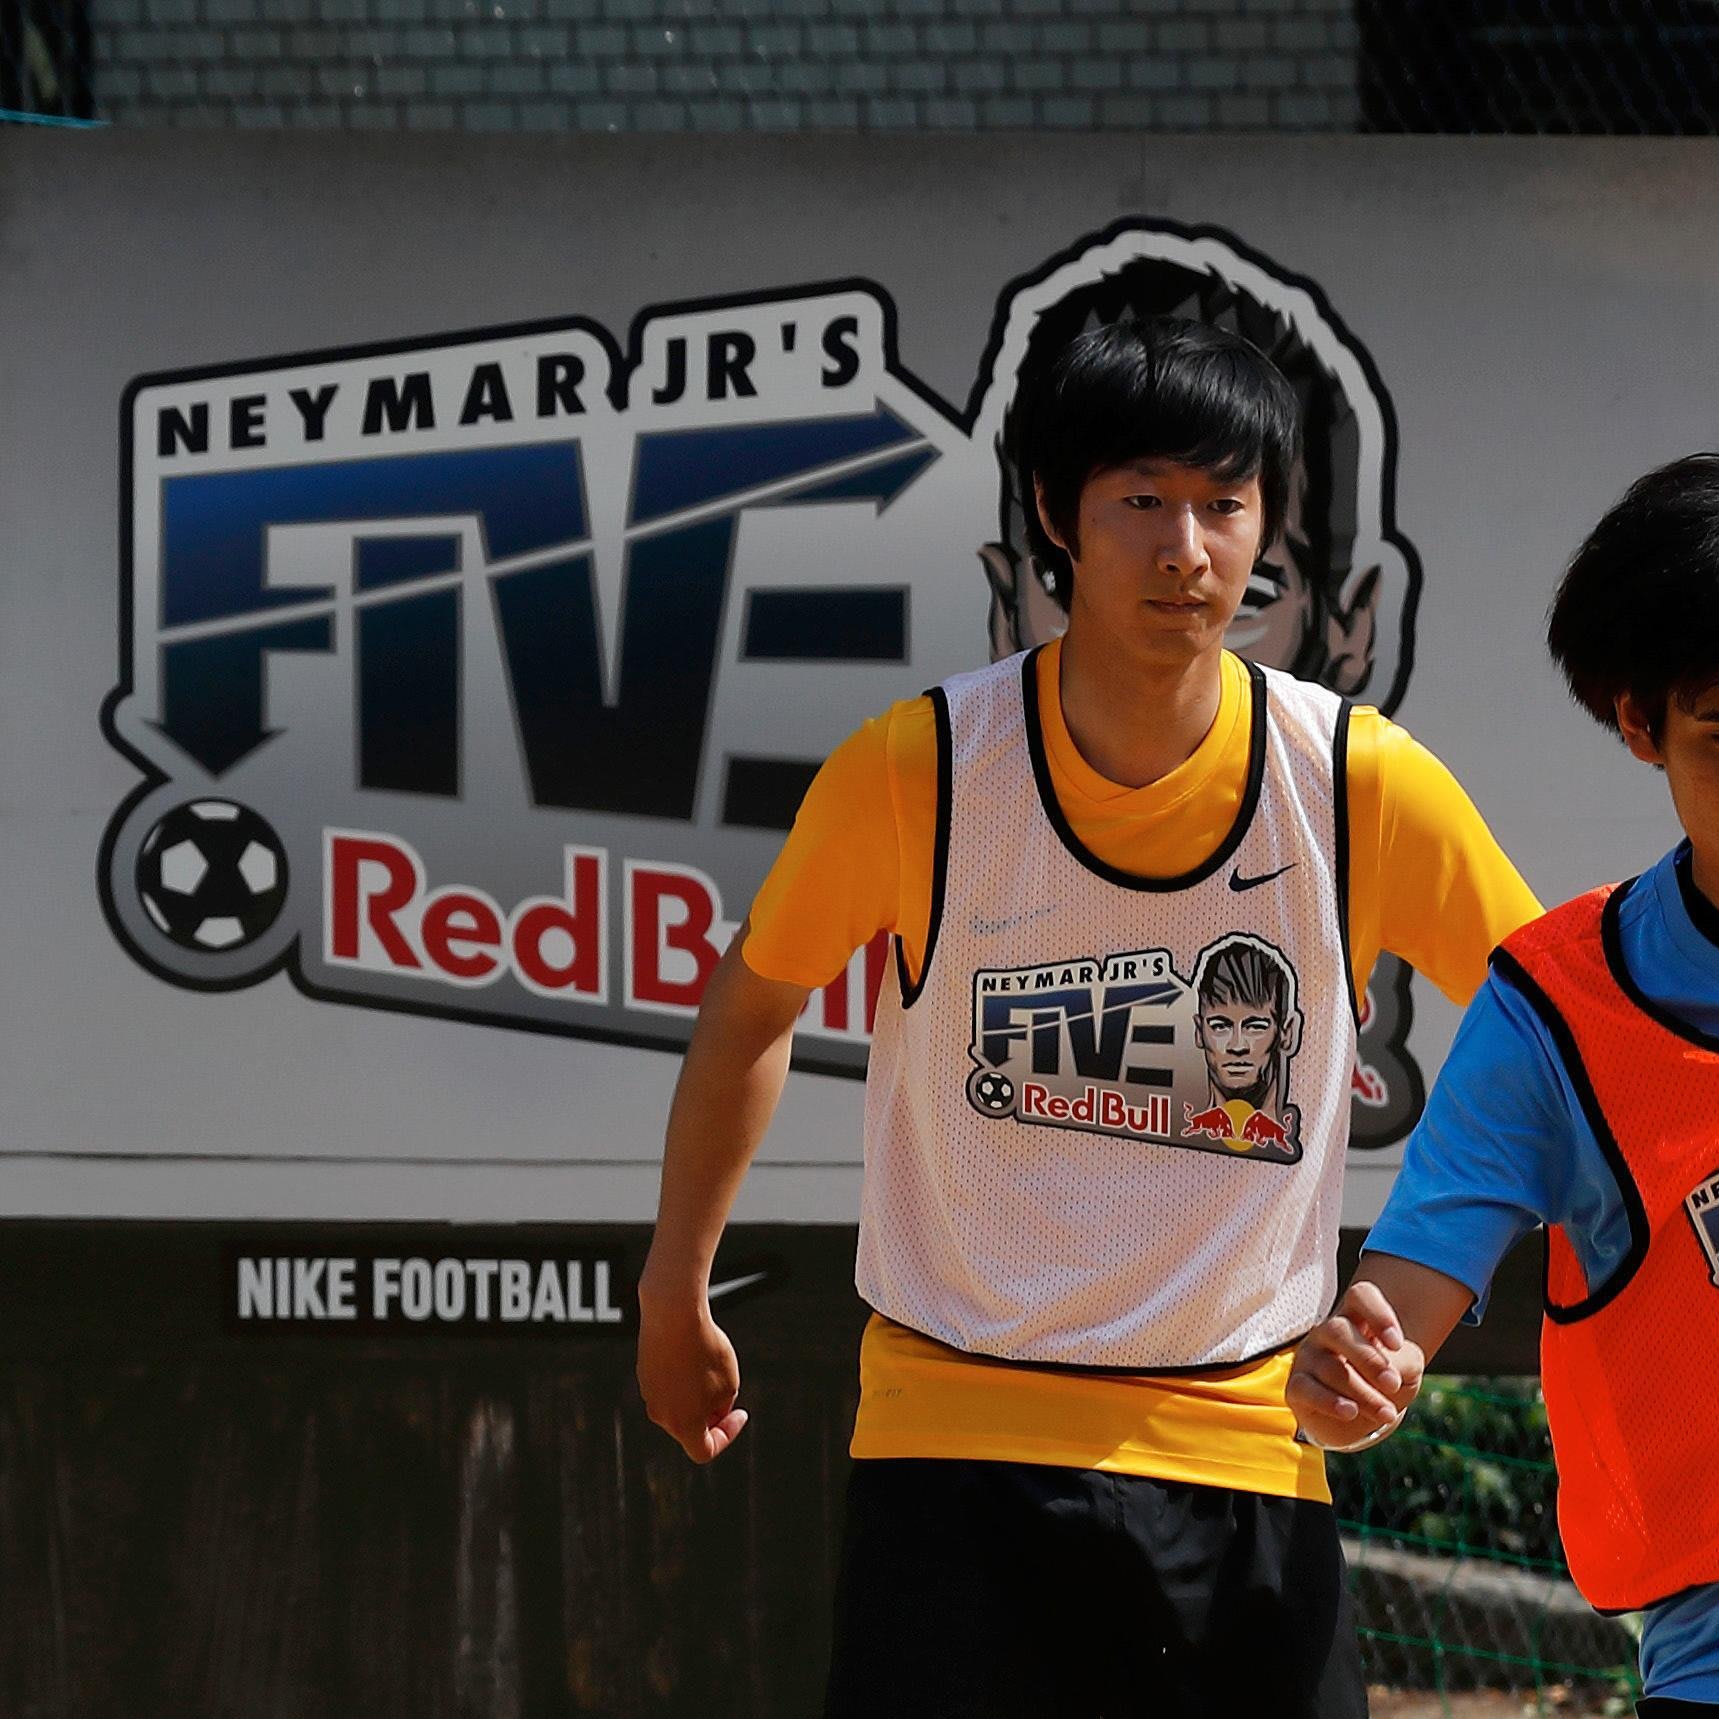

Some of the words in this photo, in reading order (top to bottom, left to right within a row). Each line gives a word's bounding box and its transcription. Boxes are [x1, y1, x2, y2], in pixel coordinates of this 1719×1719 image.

[156, 357, 590, 456] NEYMAR
[650, 314, 864, 405] JR'S
[157, 400, 940, 823] FIVE
[328, 832, 604, 998] Red
[982, 966, 1092, 991] NEYMAR
[1109, 957, 1165, 982] JR'S
[983, 979, 1183, 1087] FIVE
[1023, 1084, 1095, 1124] Red
[1101, 1091, 1169, 1136] Bull
[237, 1259, 356, 1322] NIKE
[371, 1257, 622, 1324] FOOTBALL
